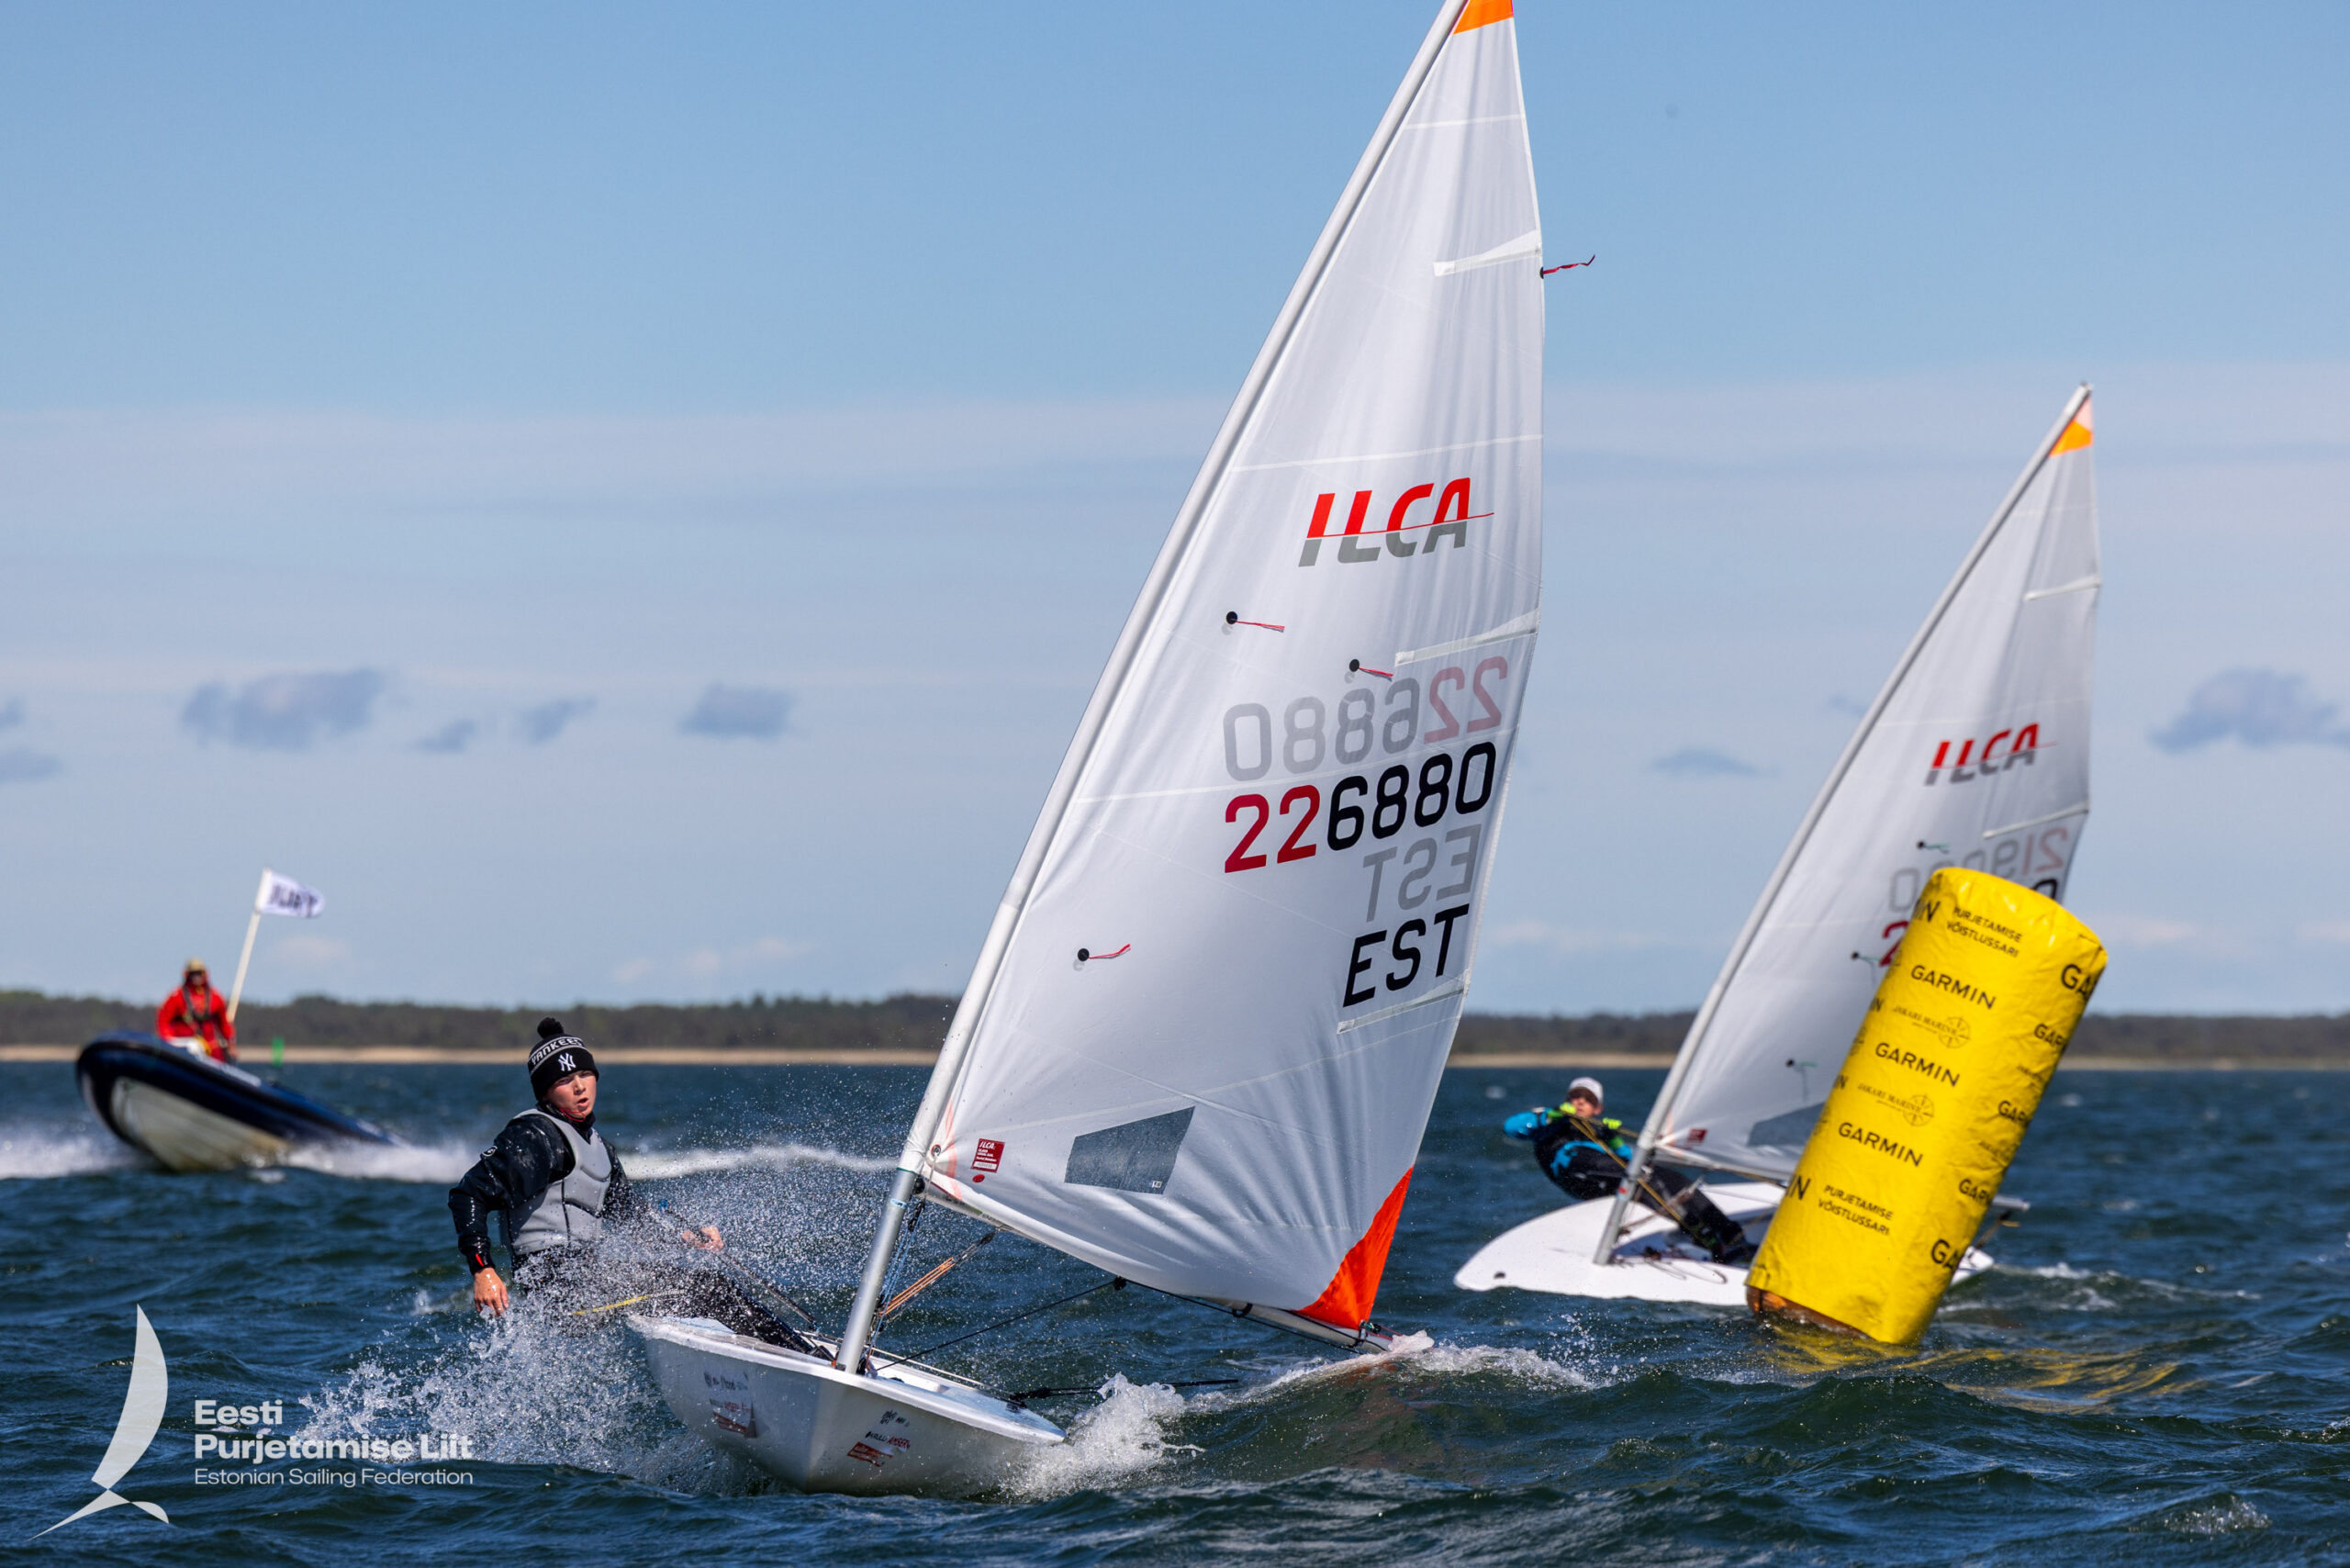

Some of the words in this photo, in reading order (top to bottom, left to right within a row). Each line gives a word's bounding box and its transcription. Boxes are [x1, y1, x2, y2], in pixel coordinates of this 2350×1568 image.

[1298, 476, 1472, 567] ILCA
[1924, 722, 2040, 787] ILCA
[1225, 741, 1497, 874] 226880
[1953, 906, 2022, 943] PURJETAMISE
[1343, 903, 1471, 1008] EST
[1910, 965, 1997, 1010] GARMIN
[557, 1052, 576, 1072] NY
[1875, 1042, 1960, 1087] GARMIN
[1838, 1122, 1923, 1167] GARMIN
[1818, 1198, 1890, 1236] VÕISTLUSSARI
[1823, 1185, 1893, 1220] PURJETAMISE
